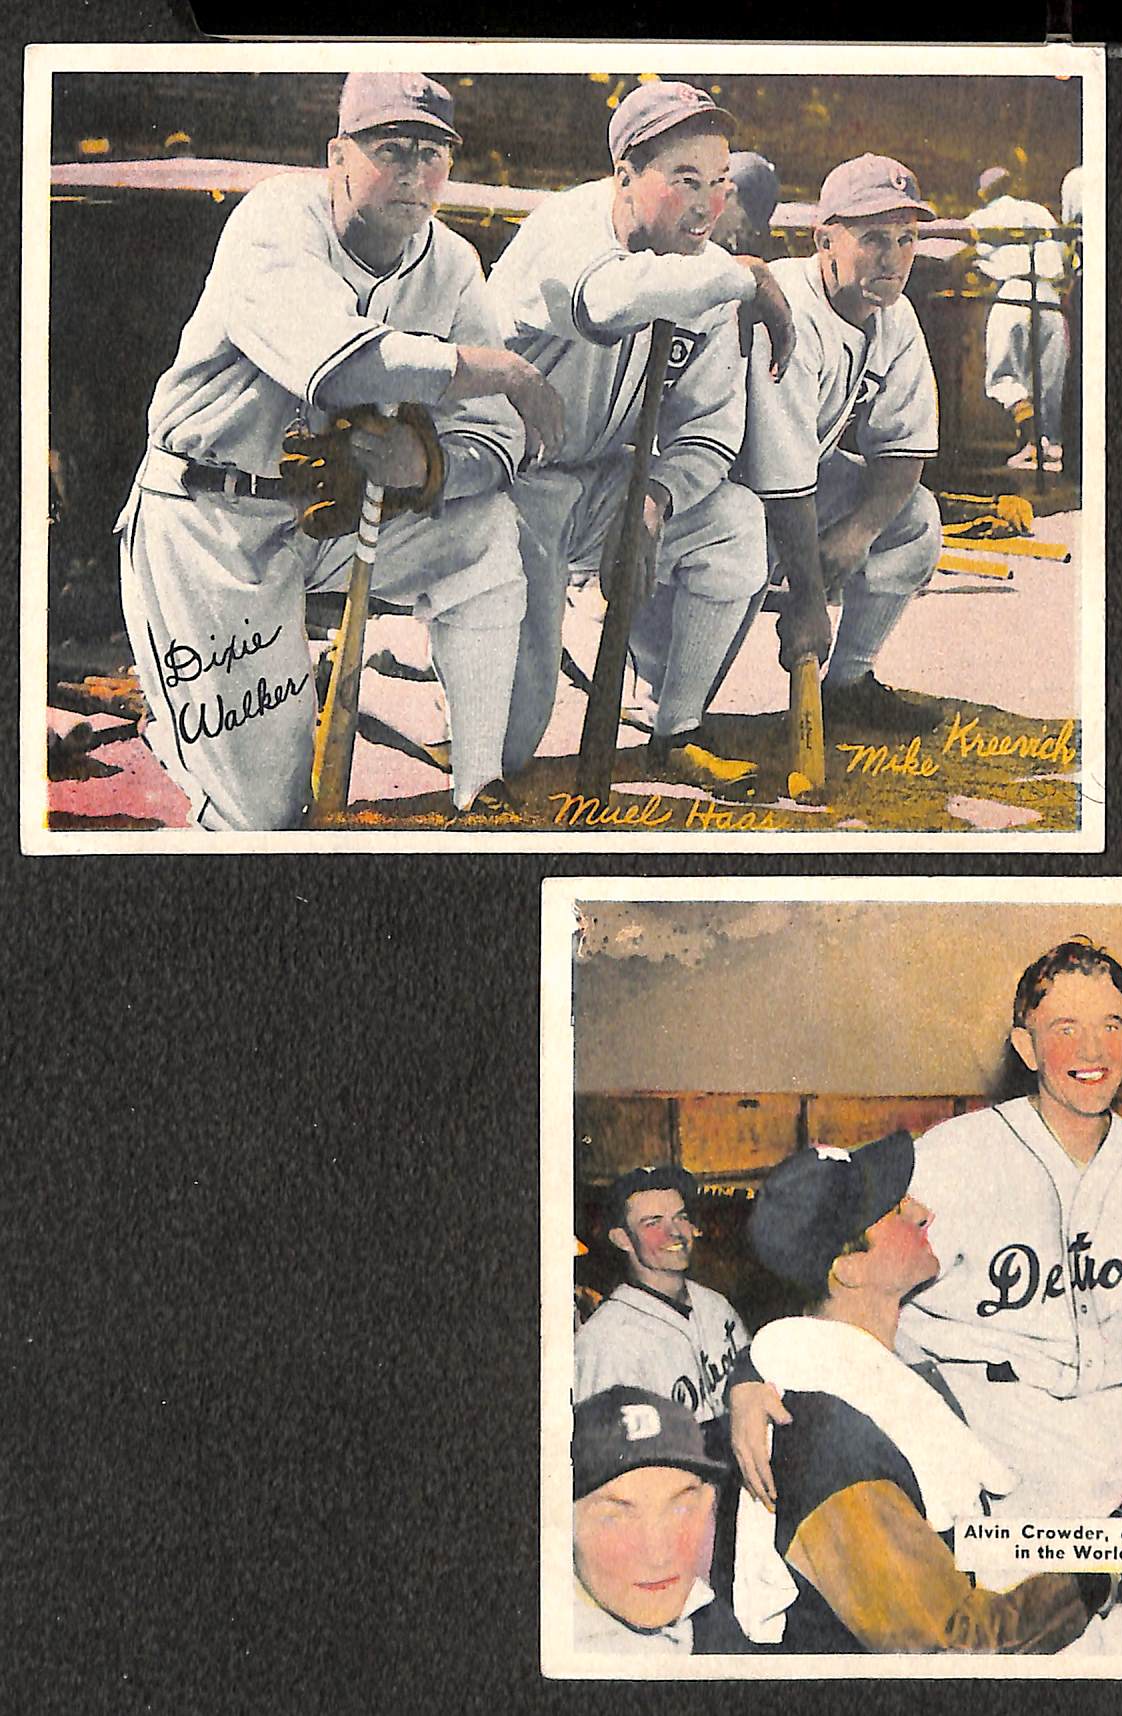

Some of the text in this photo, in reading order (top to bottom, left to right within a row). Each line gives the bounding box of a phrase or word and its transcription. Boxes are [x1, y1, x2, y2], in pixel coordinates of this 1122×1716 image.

[164, 618, 283, 688] Dixie
[179, 673, 309, 744] Walker
[836, 736, 939, 777] Mike
[620, 1404, 662, 1441] D
[964, 1524, 1010, 1540] Alvin
[1021, 1524, 1109, 1543] Crowder,
[1015, 1545, 1030, 1559] in
[1037, 1545, 1065, 1559] the
